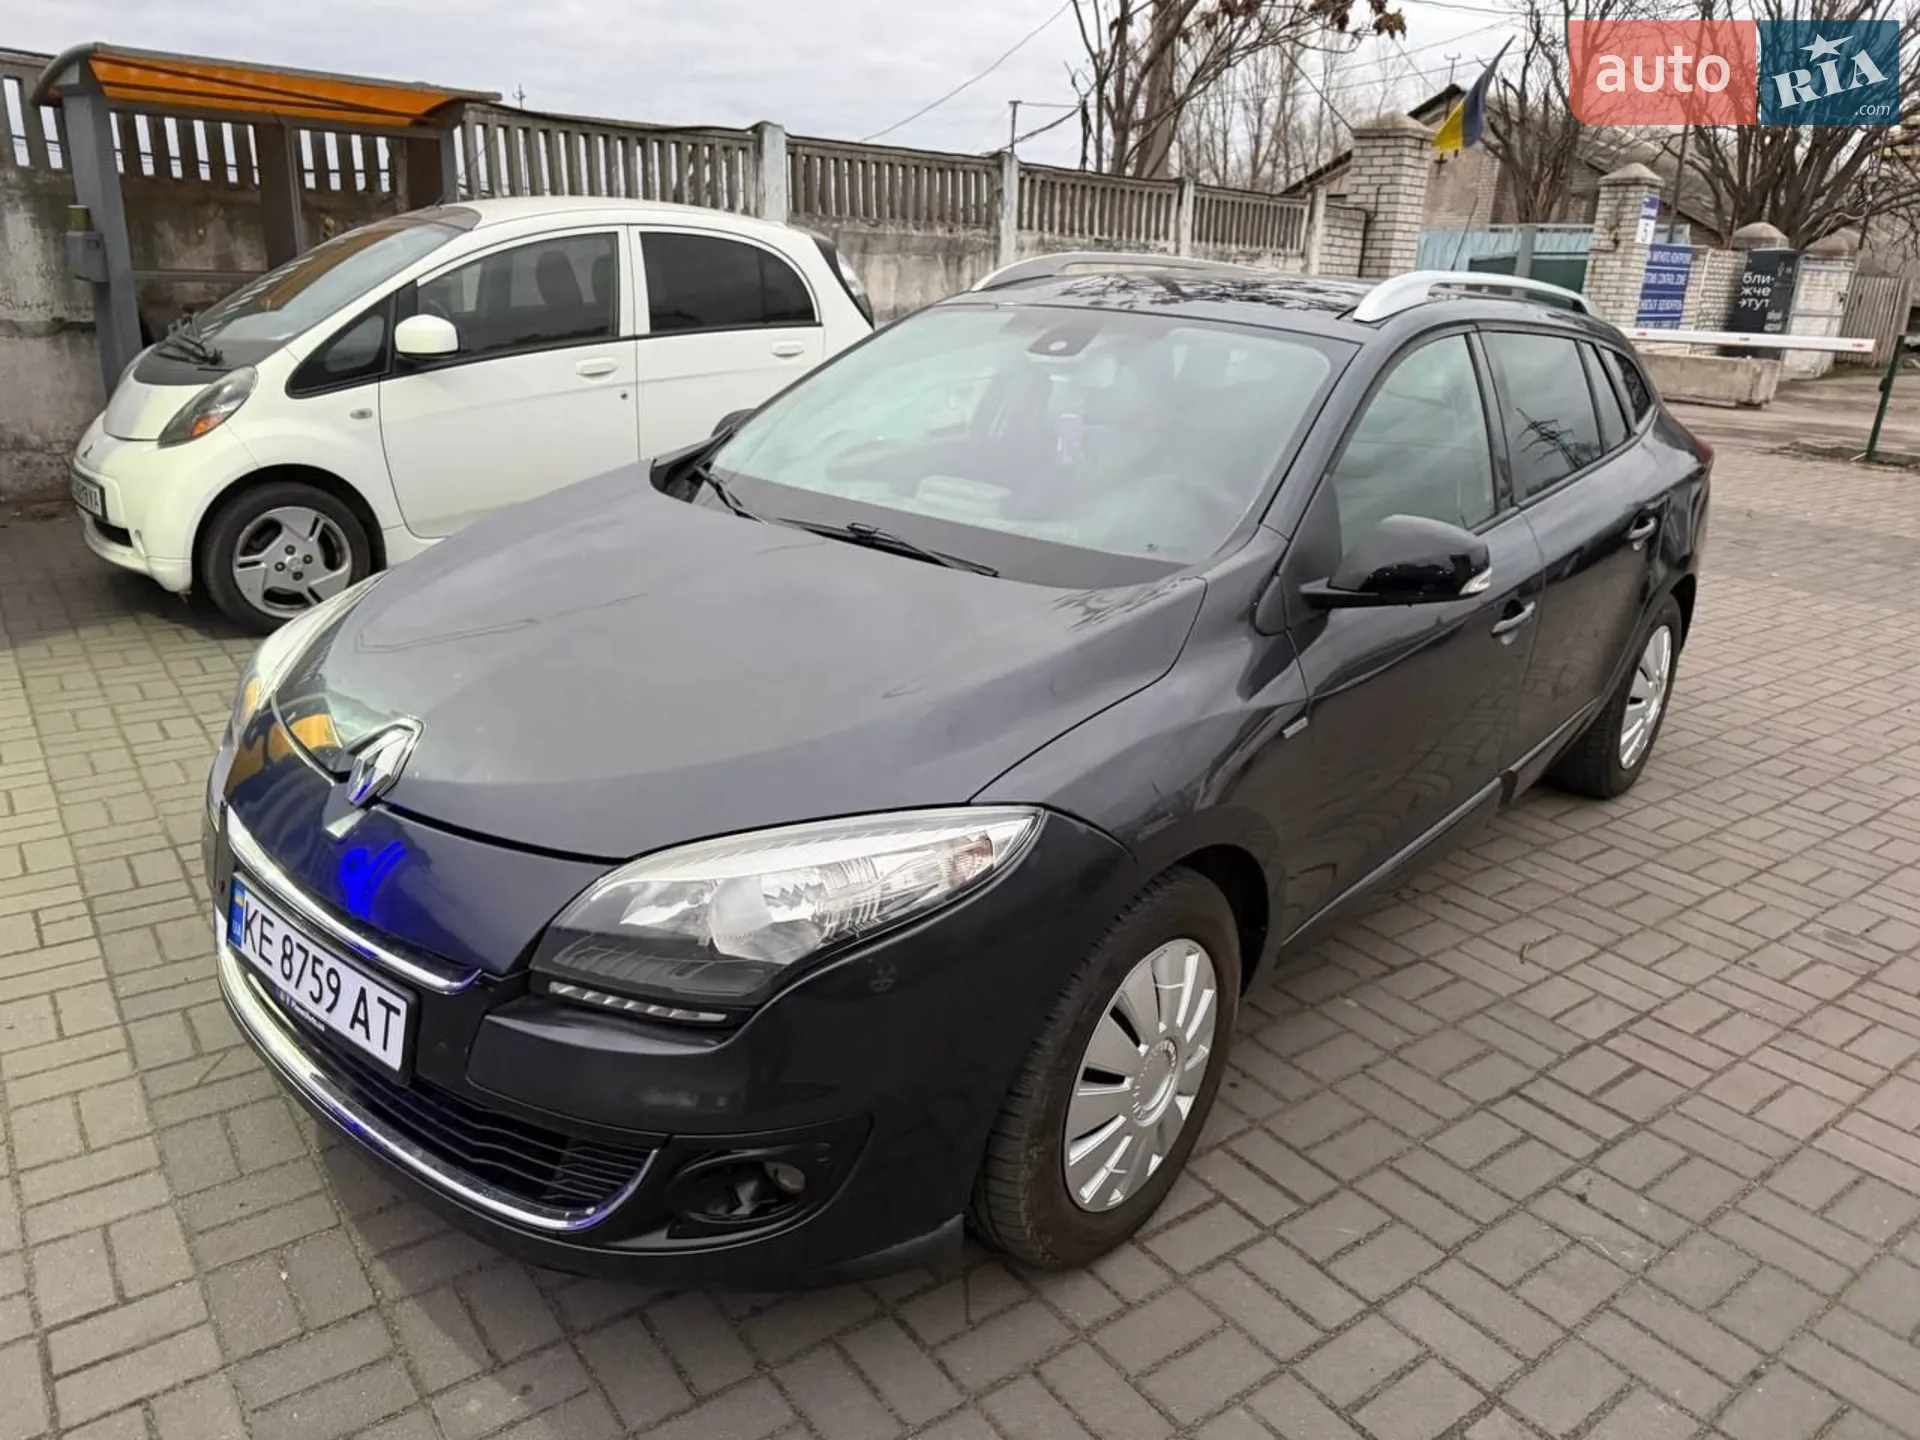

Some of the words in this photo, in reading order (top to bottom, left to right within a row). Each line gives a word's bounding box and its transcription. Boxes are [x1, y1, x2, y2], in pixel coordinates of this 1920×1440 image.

[1742, 271, 1775, 284] бли-
[1740, 286, 1772, 297] жче
[1748, 298, 1770, 311] тут
[244, 899, 274, 966] KE
[280, 934, 341, 1014] 8759
[349, 986, 401, 1052] AT
